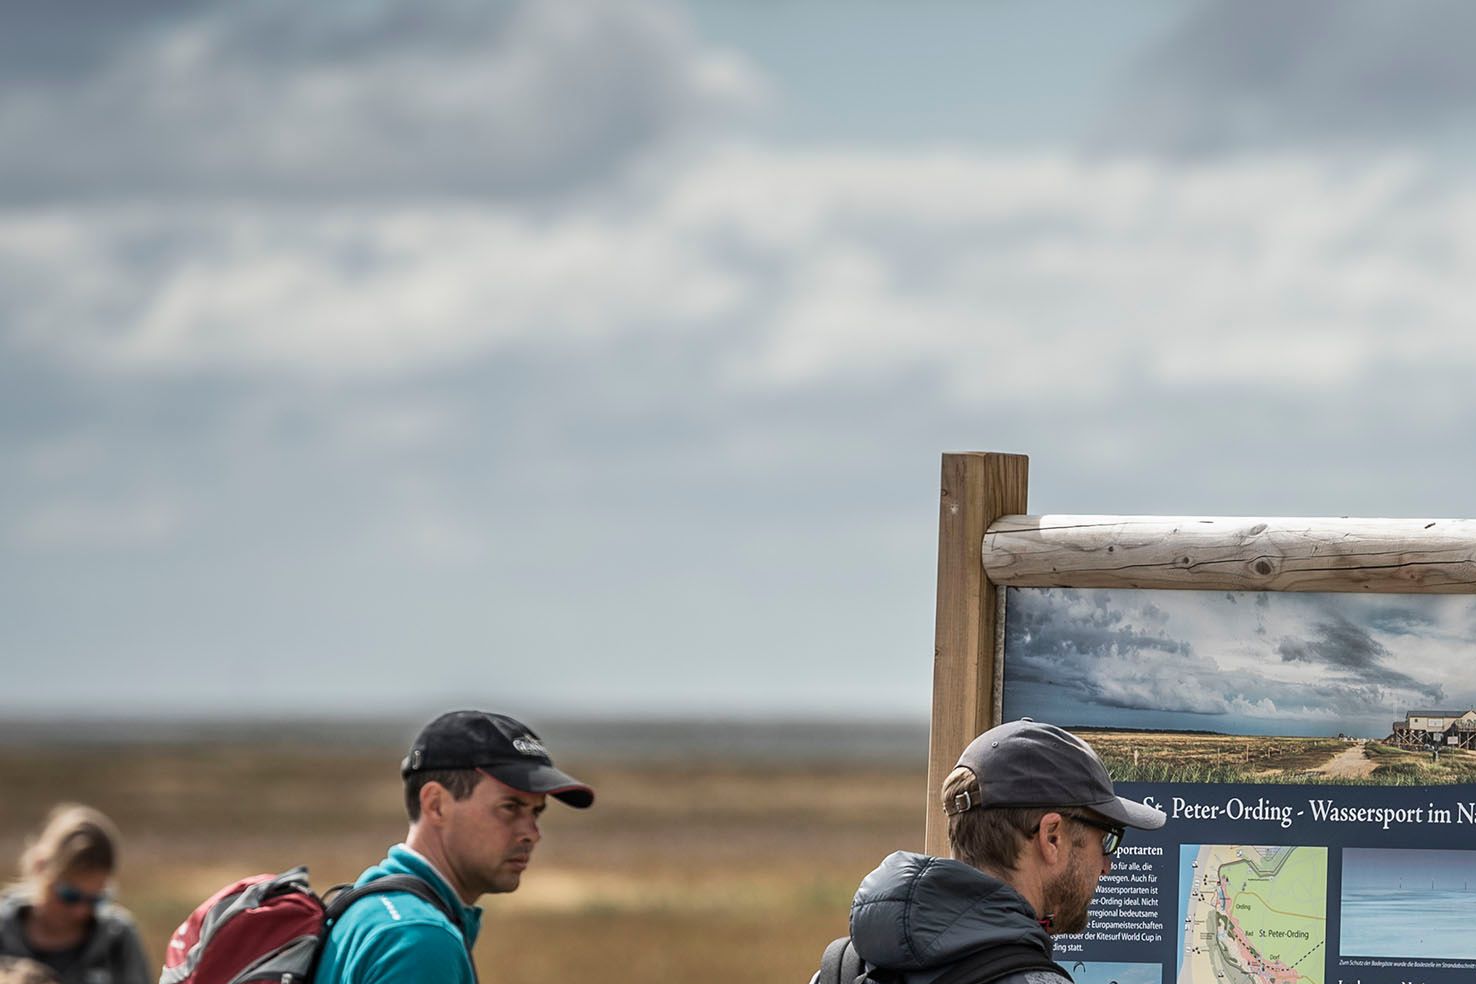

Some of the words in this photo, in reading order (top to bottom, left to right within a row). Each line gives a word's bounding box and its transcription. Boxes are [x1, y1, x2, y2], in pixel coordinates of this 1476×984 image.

[1172, 796, 1292, 827] Peter-Ording
[1309, 800, 1423, 830] Wassersport
[1428, 810, 1451, 823] im
[1119, 862, 1127, 870] für
[1129, 862, 1141, 871] alle,
[1131, 874, 1147, 882] Auch
[1148, 874, 1157, 882] für
[1124, 897, 1141, 905] ideal.
[1141, 898, 1158, 906] Nicht
[1119, 909, 1158, 918] bedeutsame
[1092, 920, 1163, 931] Europameisterschaften
[1085, 932, 1095, 940] der
[1097, 932, 1120, 940] Kitesurf
[1122, 933, 1140, 941] World
[1141, 933, 1154, 942] Cup
[1259, 929, 1267, 938] St.
[1268, 929, 1309, 941] Peter-Ording
